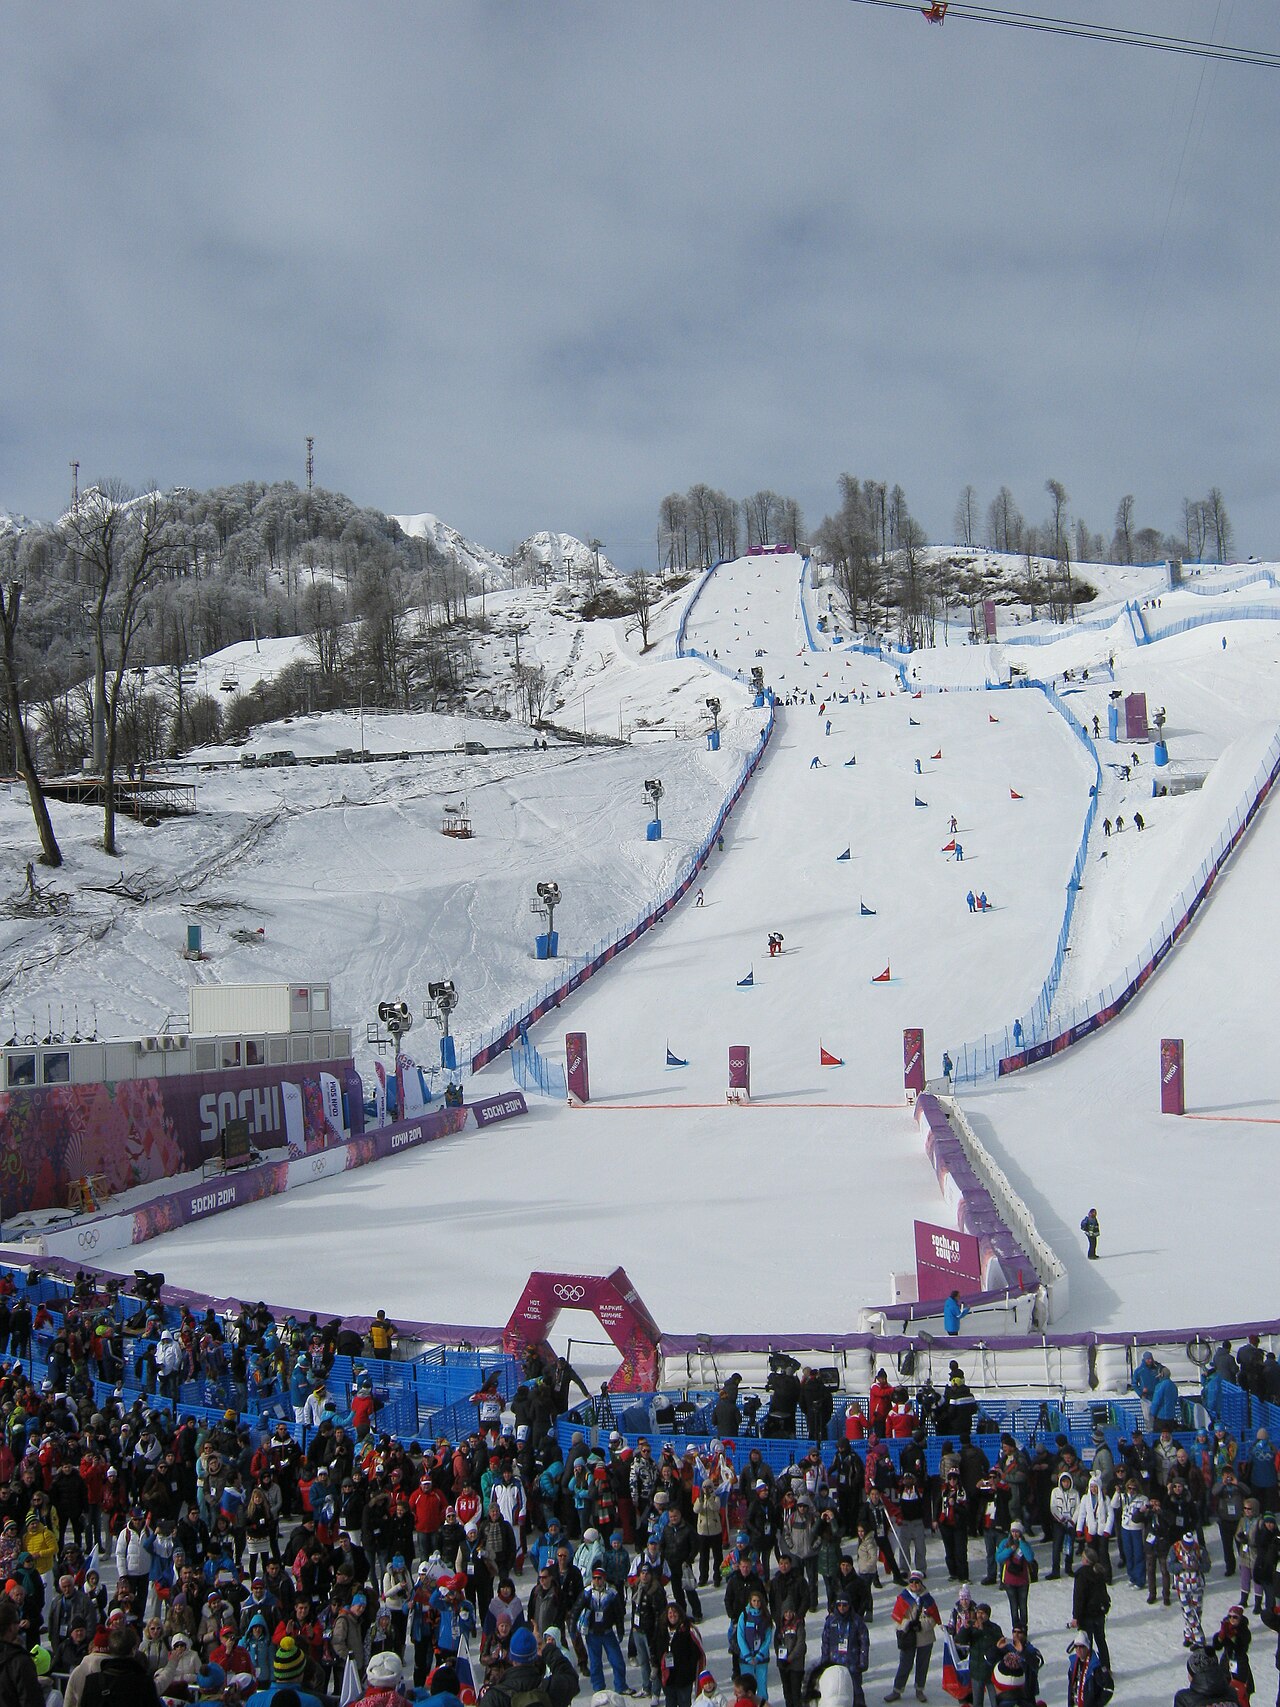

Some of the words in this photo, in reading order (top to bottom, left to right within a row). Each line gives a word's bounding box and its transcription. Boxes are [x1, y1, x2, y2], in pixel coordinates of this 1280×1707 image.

[569, 1056, 582, 1075] FINISH
[1163, 1064, 1178, 1084] FINISH
[200, 1086, 280, 1142] SOCHI
[481, 1104, 505, 1120] SOCHI
[504, 1098, 523, 1113] 2014
[408, 1126, 422, 1143] 2014
[191, 1193, 216, 1215] SOCHI
[217, 1187, 236, 1207] 2014
[931, 1234, 960, 1252] sochi.ru
[460, 1500, 475, 1510] RU
